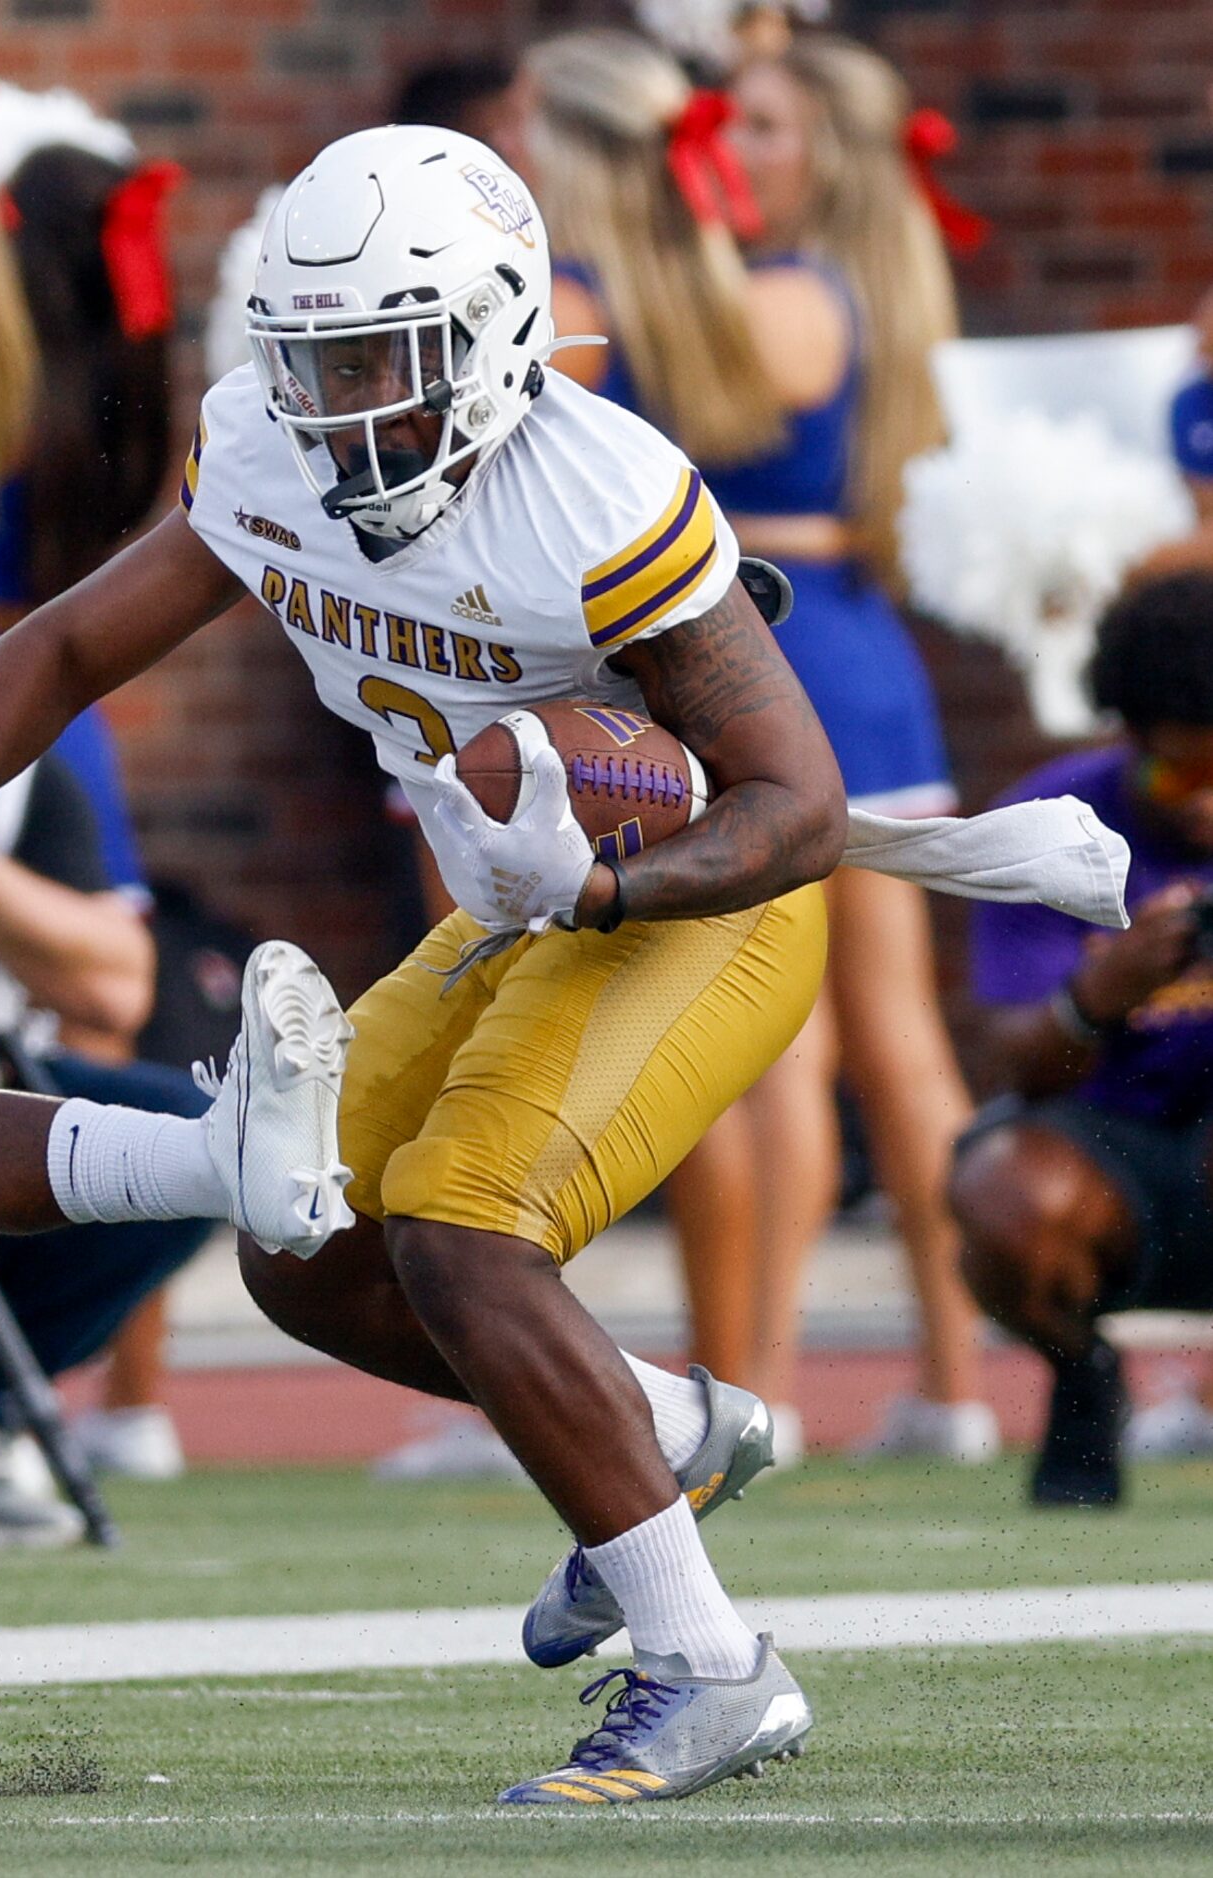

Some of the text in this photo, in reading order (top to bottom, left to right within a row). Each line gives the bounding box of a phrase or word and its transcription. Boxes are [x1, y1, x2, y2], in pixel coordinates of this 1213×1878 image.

[292, 292, 345, 310] THE HILL
[287, 375, 319, 418] Ridde
[367, 502, 392, 513] dell
[250, 516, 302, 551] SWAC
[261, 564, 524, 684] PANTHERS
[450, 603, 503, 627] adidas
